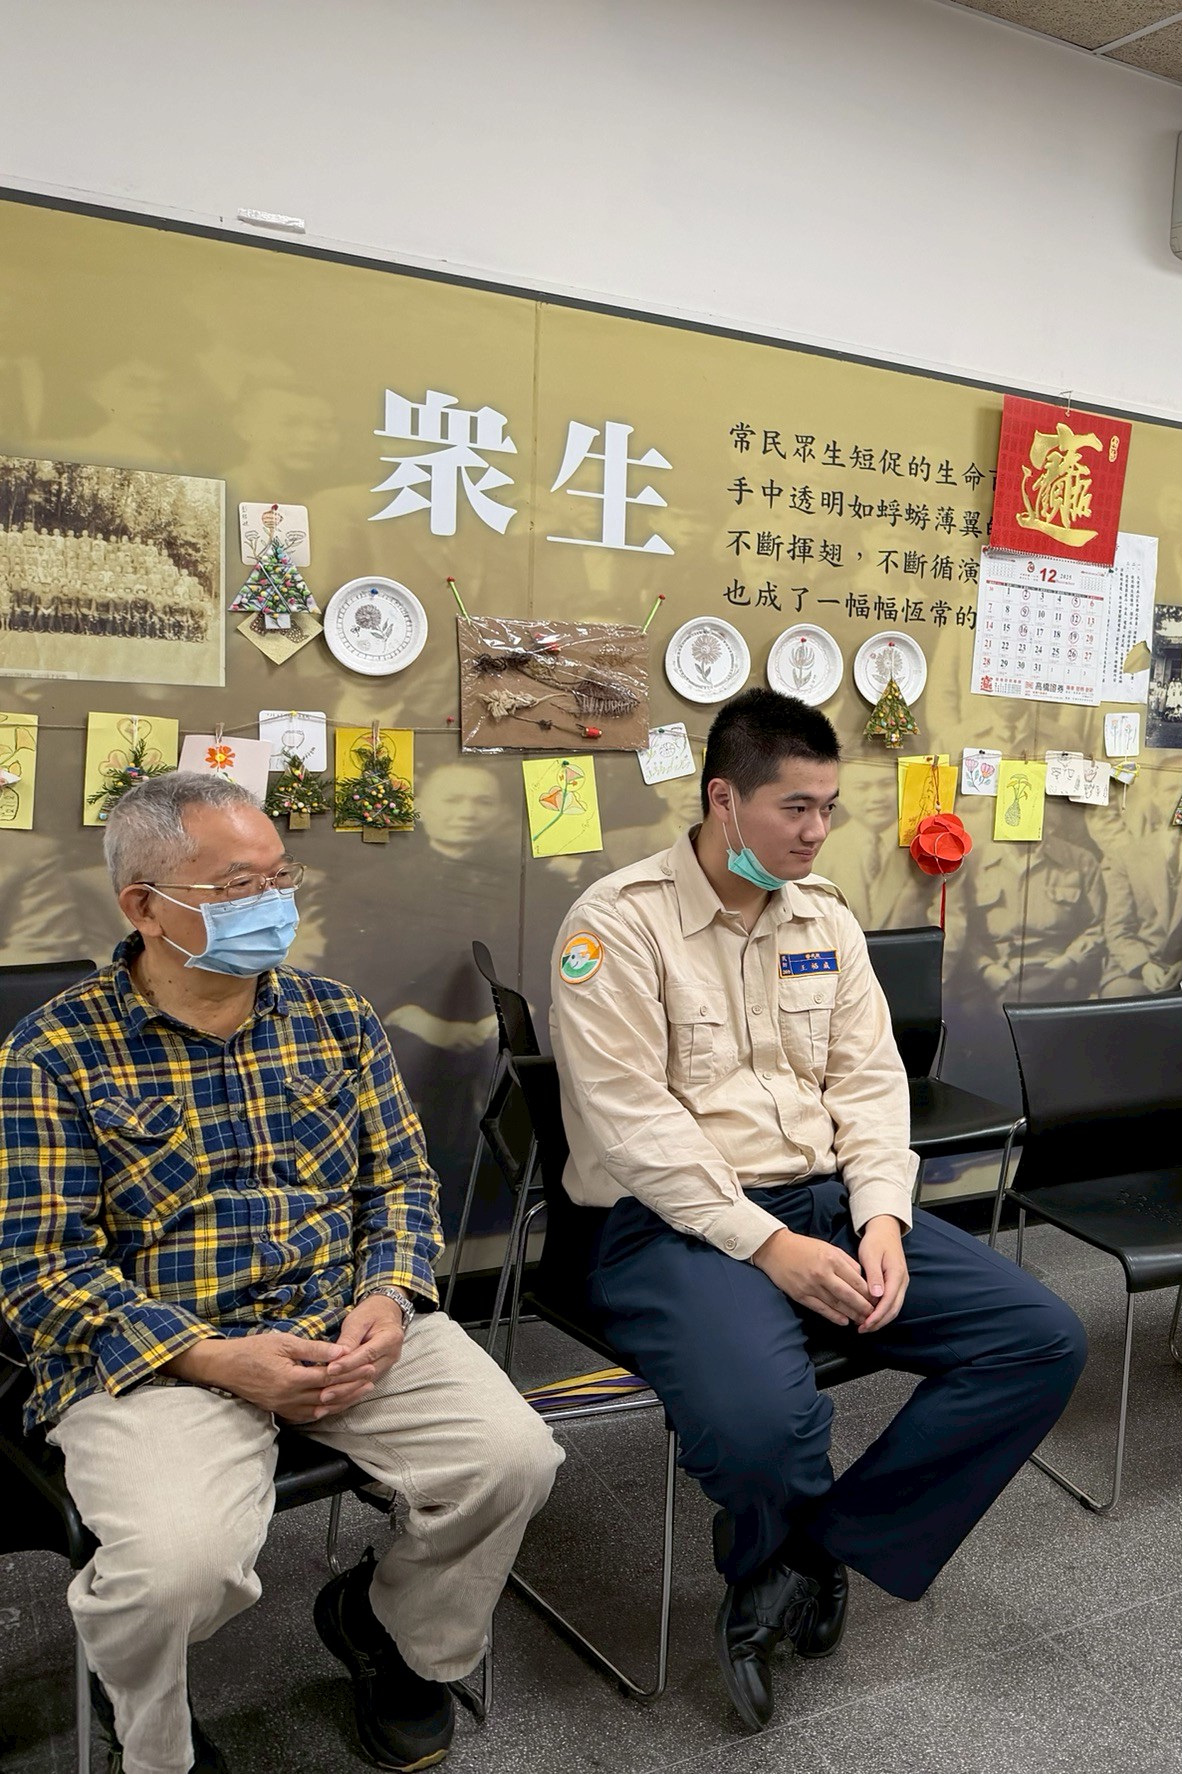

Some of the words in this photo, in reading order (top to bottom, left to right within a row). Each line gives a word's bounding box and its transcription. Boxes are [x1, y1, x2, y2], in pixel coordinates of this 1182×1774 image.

[1039, 567, 1057, 583] 12
[722, 578, 977, 631] 也成了一幅幅恆常的
[1038, 610, 1045, 618] 10
[1055, 612, 1062, 620] 11
[1072, 614, 1079, 622] 12
[1087, 617, 1095, 625] 13
[986, 621, 993, 629] 14
[1003, 623, 1011, 632] 15
[1020, 625, 1027, 634] 16
[1036, 628, 1044, 636] 17
[1053, 630, 1061, 638] 18
[1070, 632, 1077, 640] 19
[1086, 634, 1094, 642] 20
[984, 639, 992, 648] 21
[1001, 642, 1009, 650] 22
[1018, 643, 1026, 652] 23
[1034, 646, 1042, 654] 24
[1051, 648, 1060, 656] 25
[1068, 650, 1076, 658] 26
[1084, 652, 1092, 660] 27
[982, 657, 991, 666] 28
[1000, 659, 1008, 668] 29
[1017, 661, 1025, 669] 30
[1033, 663, 1041, 671] 31
